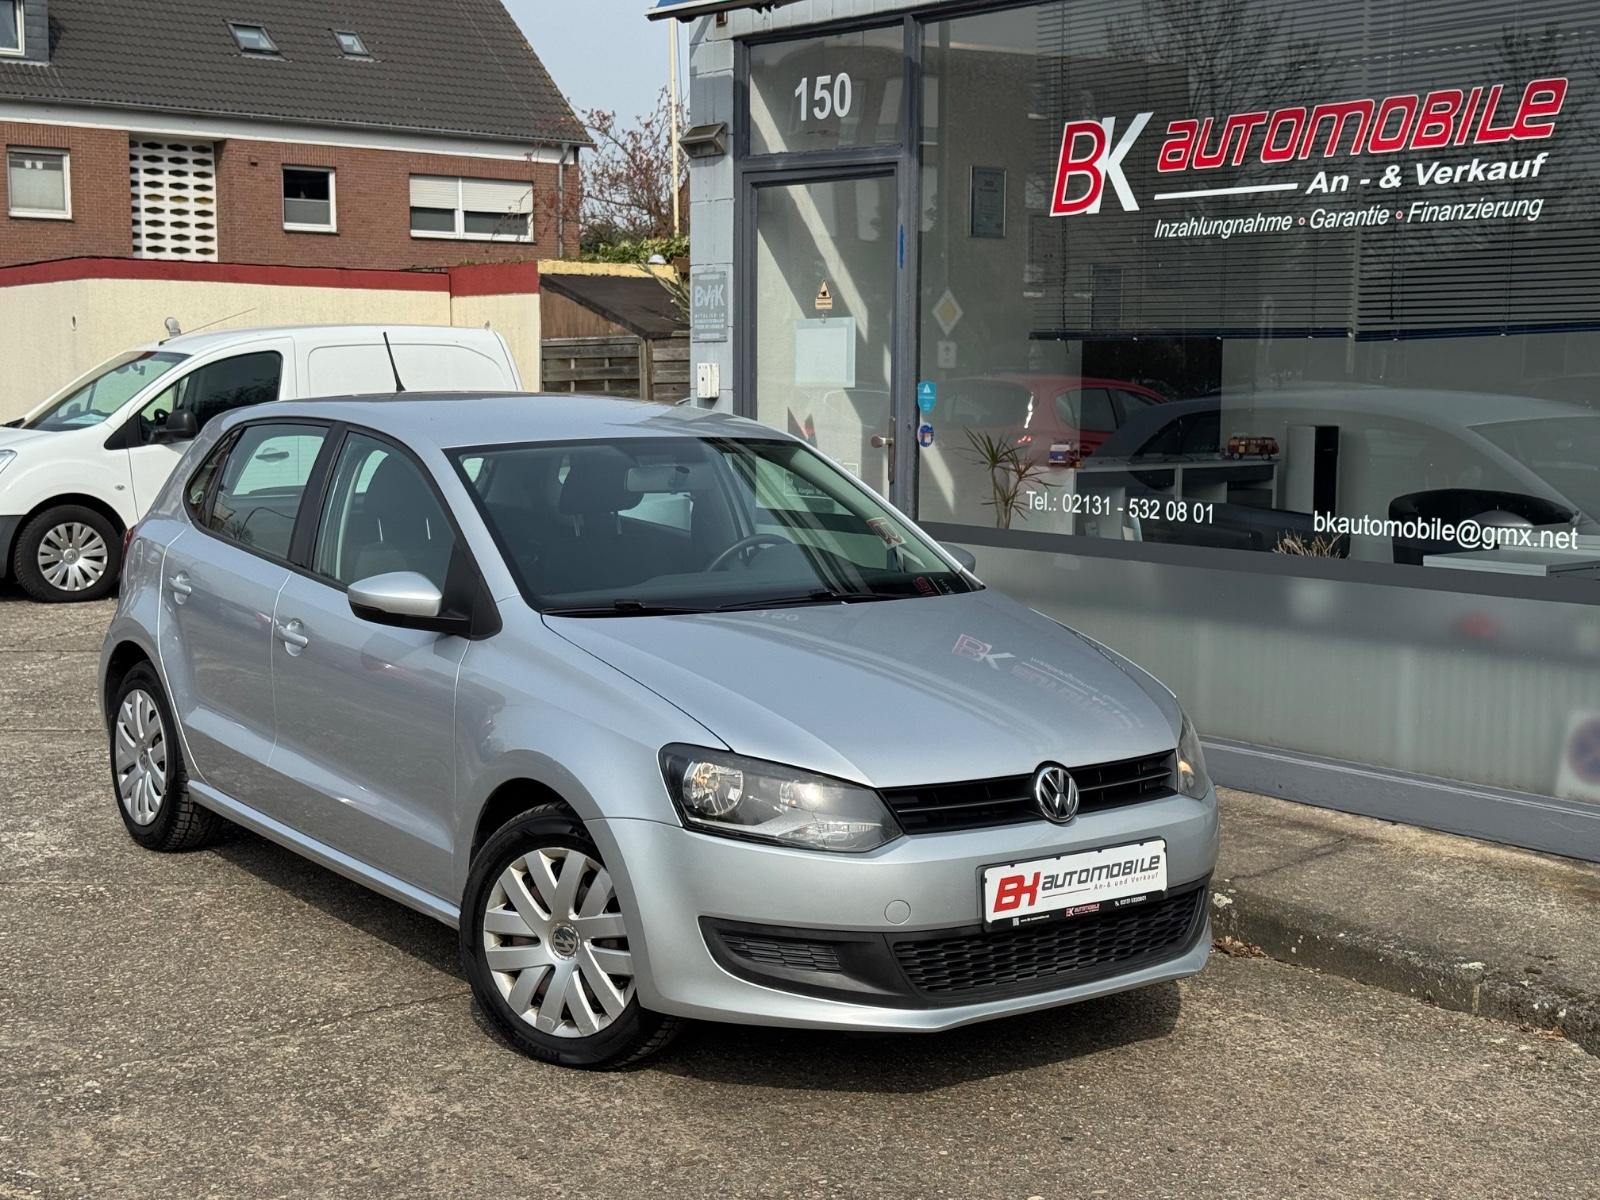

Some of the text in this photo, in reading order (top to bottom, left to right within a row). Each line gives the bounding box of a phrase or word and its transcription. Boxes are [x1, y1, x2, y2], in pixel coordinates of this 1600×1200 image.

[795, 72, 852, 121] 150
[1049, 111, 1154, 217] BK
[1305, 171, 1349, 194] An
[1379, 165, 1403, 189] &
[1415, 152, 1550, 186] Verkauf
[1154, 197, 1544, 239] Inzahlungnahme Garantie Finanzierung
[1026, 491, 1057, 512] Tel.:
[1062, 493, 1111, 516] 02131
[1129, 498, 1160, 520] 532
[1166, 501, 1188, 522] 08
[1193, 503, 1215, 524] 01
[1313, 510, 1580, 550] bkautomobile@gmx.net
[993, 871, 1041, 913] BK
[1114, 877, 1128, 887] und
[1131, 872, 1159, 884] Verkauf
